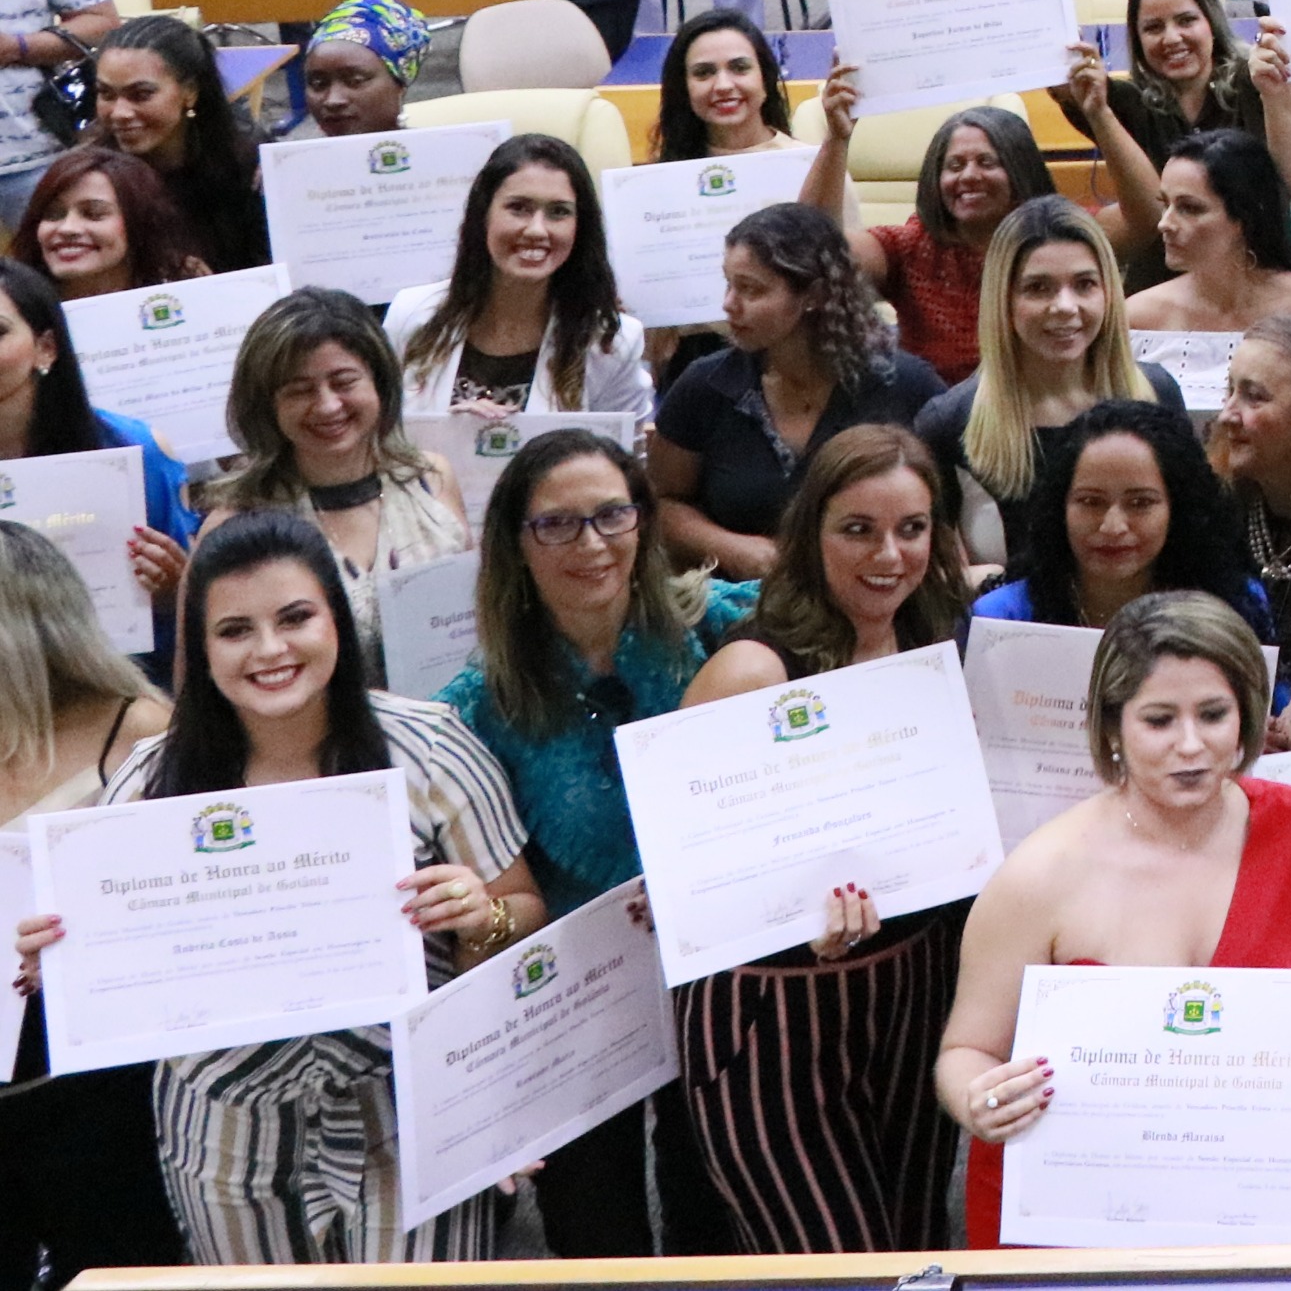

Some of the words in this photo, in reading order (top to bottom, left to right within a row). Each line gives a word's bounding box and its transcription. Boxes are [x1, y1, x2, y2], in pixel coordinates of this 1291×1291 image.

[688, 770, 757, 795] Diploma
[762, 762, 780, 776] de
[716, 790, 766, 809] Câmara
[100, 875, 172, 895] Diploma
[180, 871, 197, 884] de
[204, 864, 260, 880] Honra
[266, 860, 286, 873] ao
[293, 851, 349, 869] Mérito
[127, 896, 180, 911] Câmara
[185, 884, 252, 903] Municipal
[257, 882, 271, 893] de
[276, 876, 329, 890] Goiânia
[445, 1029, 501, 1066] Diploma
[504, 1018, 518, 1033] de
[523, 992, 563, 1021] Honra
[565, 981, 580, 997] ao
[584, 954, 623, 985] Mérito
[1070, 1046, 1136, 1066] Diploma
[1144, 1048, 1161, 1064] de
[1168, 1048, 1219, 1066] Honra
[1225, 1054, 1245, 1066] ao
[1089, 1072, 1139, 1086] Câmara
[1144, 1073, 1208, 1090] Municipal
[1213, 1075, 1227, 1088] de
[1231, 1076, 1282, 1089] Goiânia
[1142, 1130, 1177, 1141] Blenda
